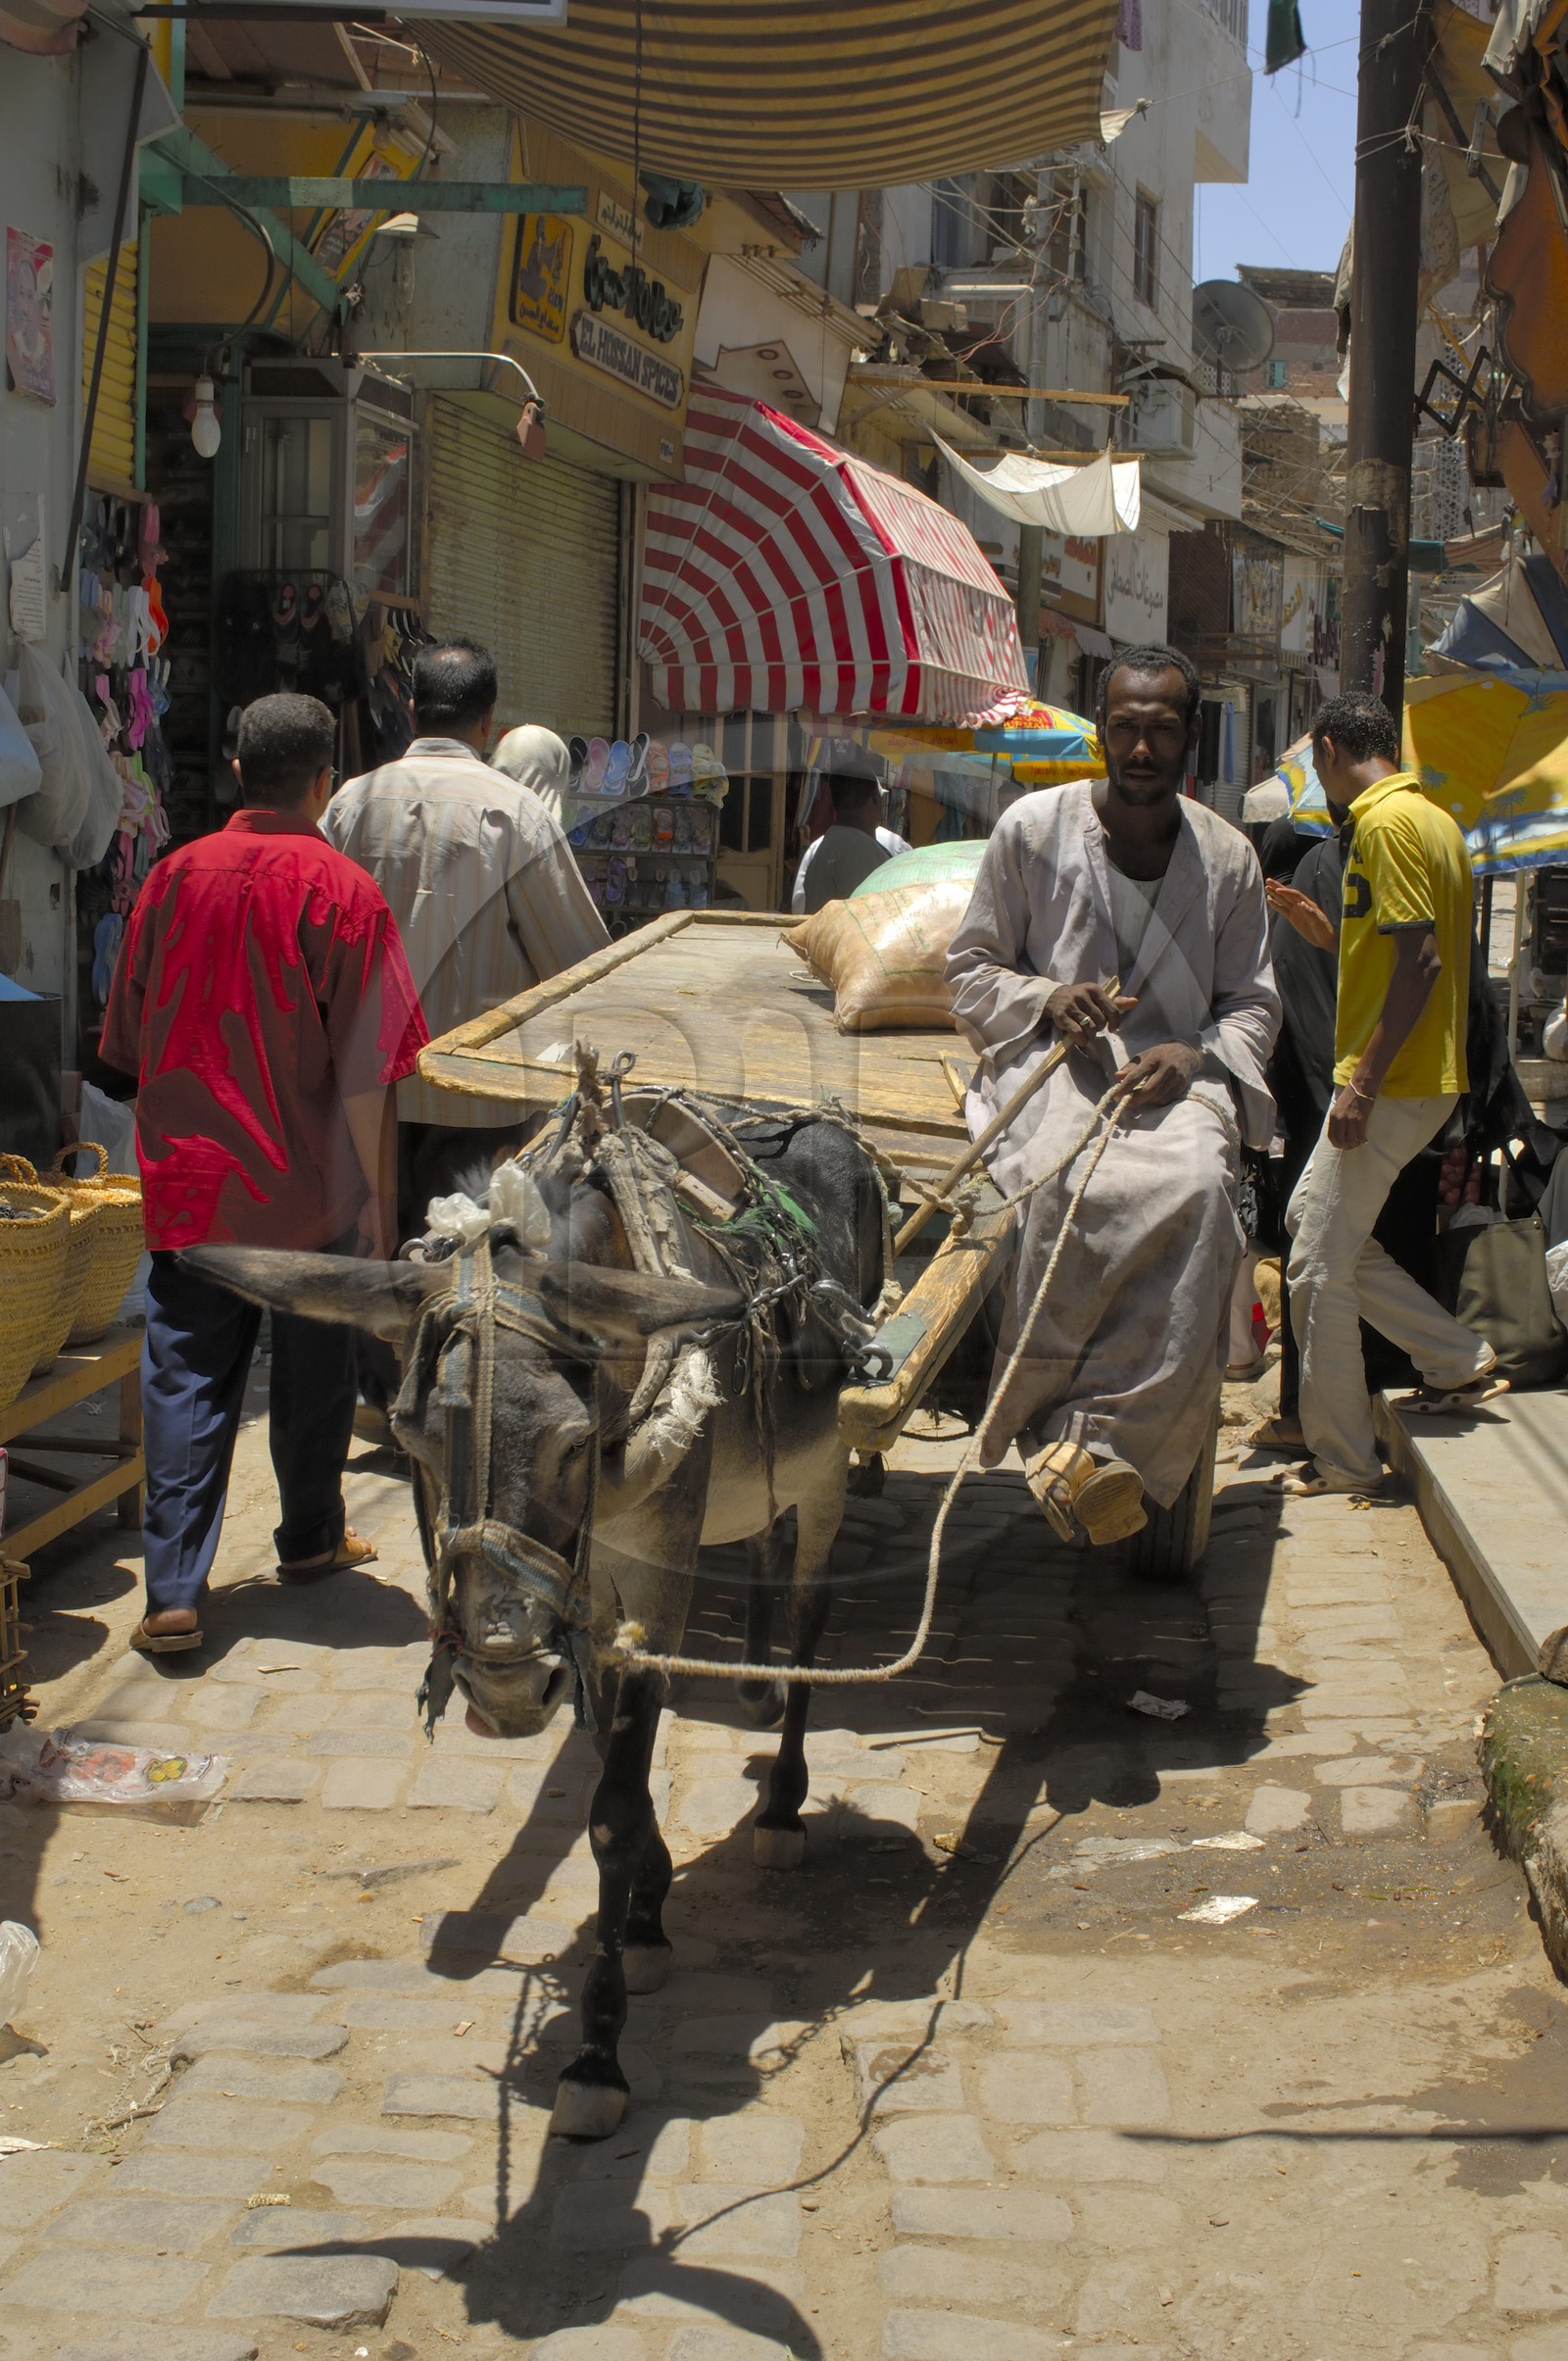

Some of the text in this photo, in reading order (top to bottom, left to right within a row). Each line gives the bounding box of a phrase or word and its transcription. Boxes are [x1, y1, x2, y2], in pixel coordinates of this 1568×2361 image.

[579, 318, 596, 359] EL
[598, 327, 641, 383] HOSSAN
[641, 354, 680, 403] SPICES
